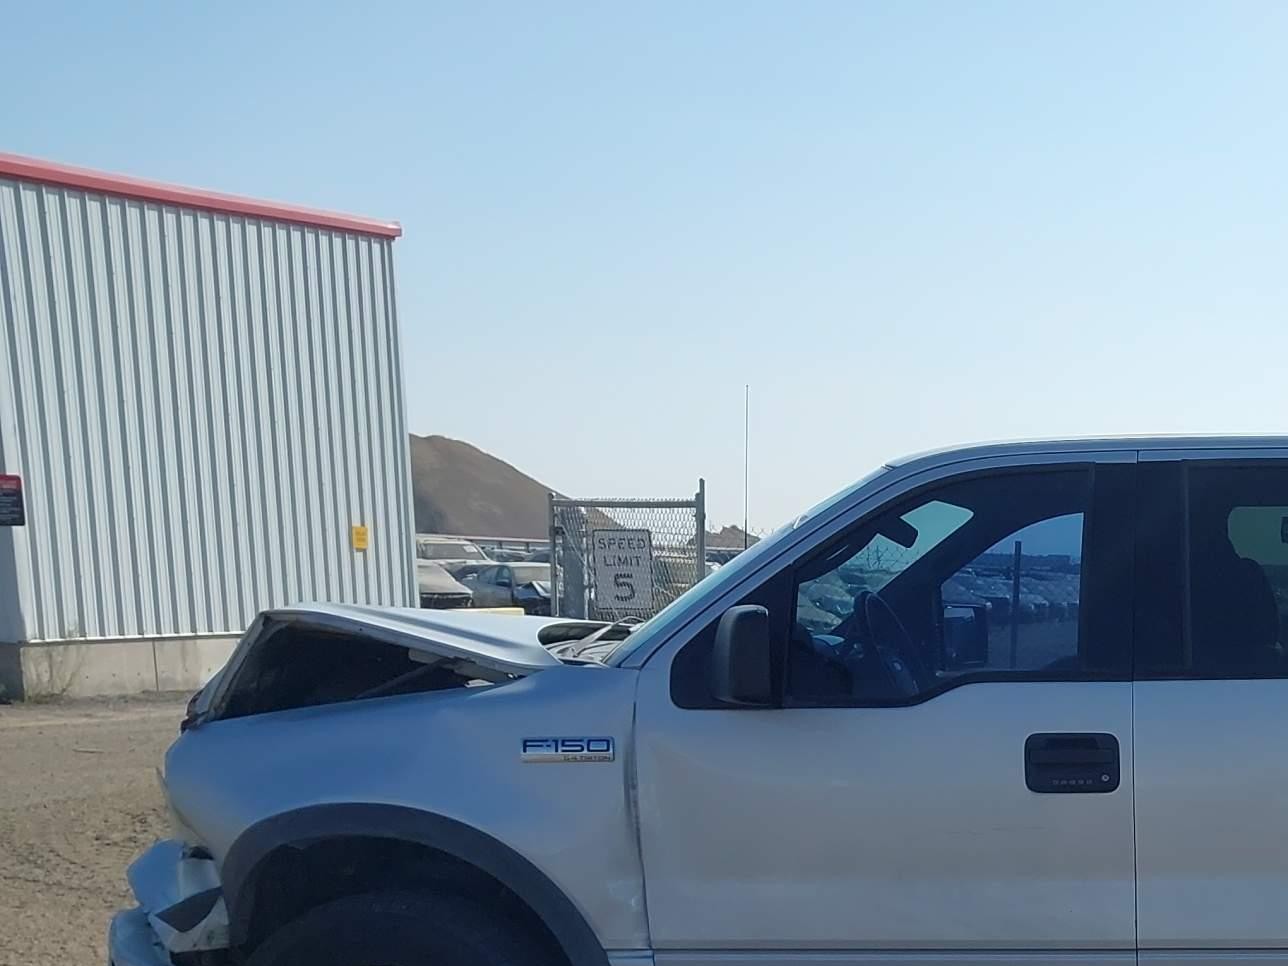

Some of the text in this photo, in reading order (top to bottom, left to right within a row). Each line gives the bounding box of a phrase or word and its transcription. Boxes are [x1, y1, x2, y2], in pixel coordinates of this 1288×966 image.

[598, 537, 646, 550] SPEED
[603, 554, 641, 567] LIMIT
[614, 573, 635, 601] 5
[522, 738, 611, 753] F-150
